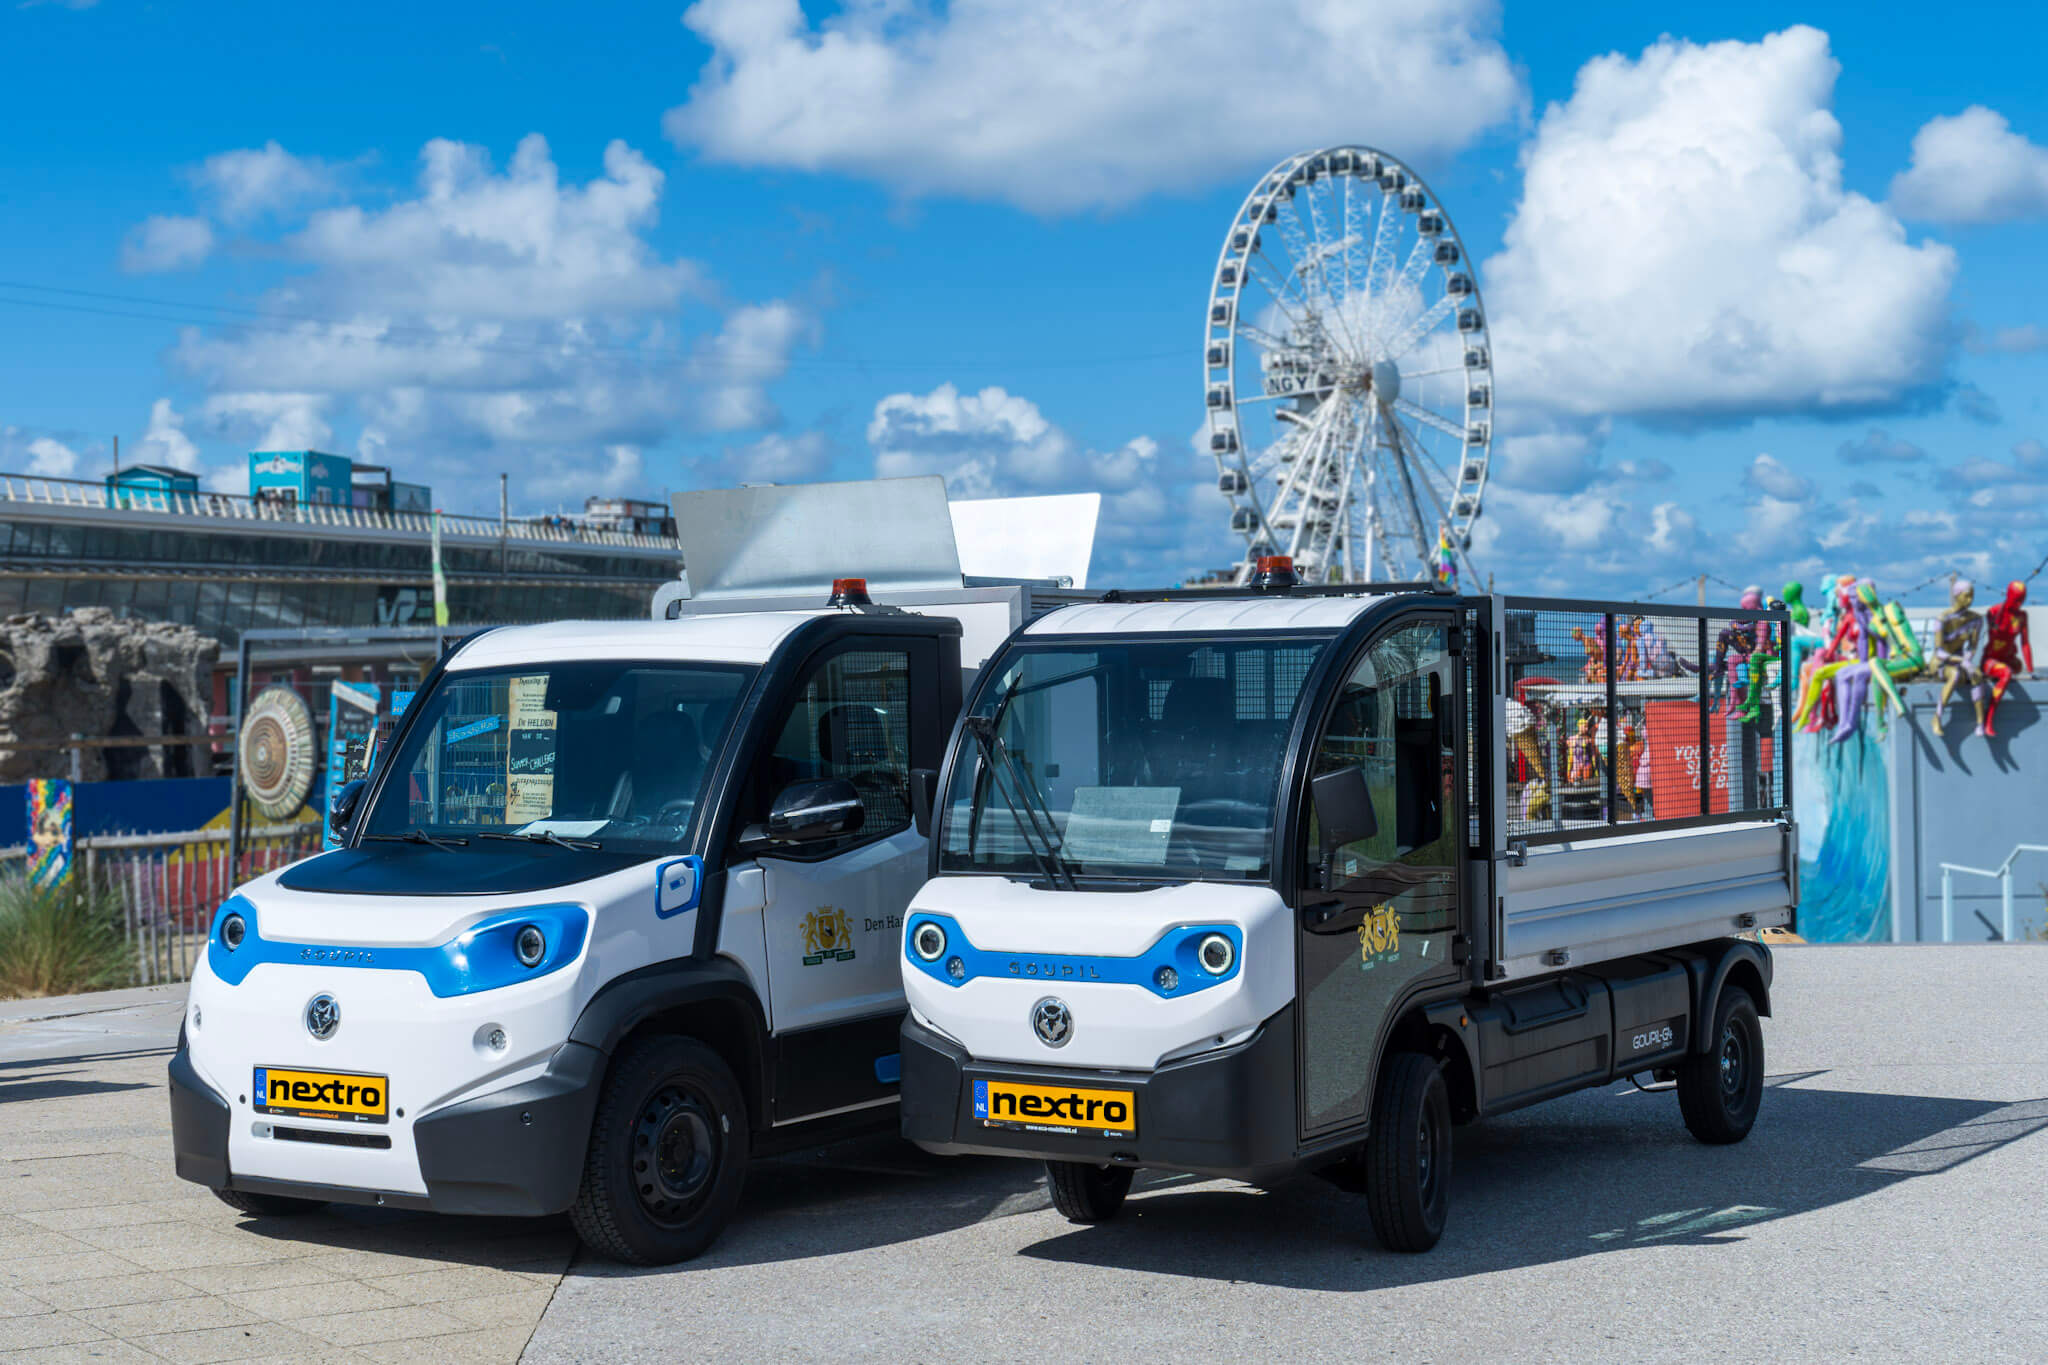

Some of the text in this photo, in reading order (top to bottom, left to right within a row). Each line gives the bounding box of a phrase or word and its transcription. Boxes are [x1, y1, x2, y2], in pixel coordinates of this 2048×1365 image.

[864, 918, 885, 932] Den
[300, 949, 375, 963] GOUPIL
[1009, 961, 1100, 978] GOUPIL
[256, 1089, 265, 1100] NL
[269, 1079, 380, 1107] nextro
[975, 1102, 987, 1112] NL
[992, 1092, 1127, 1123] nextro
